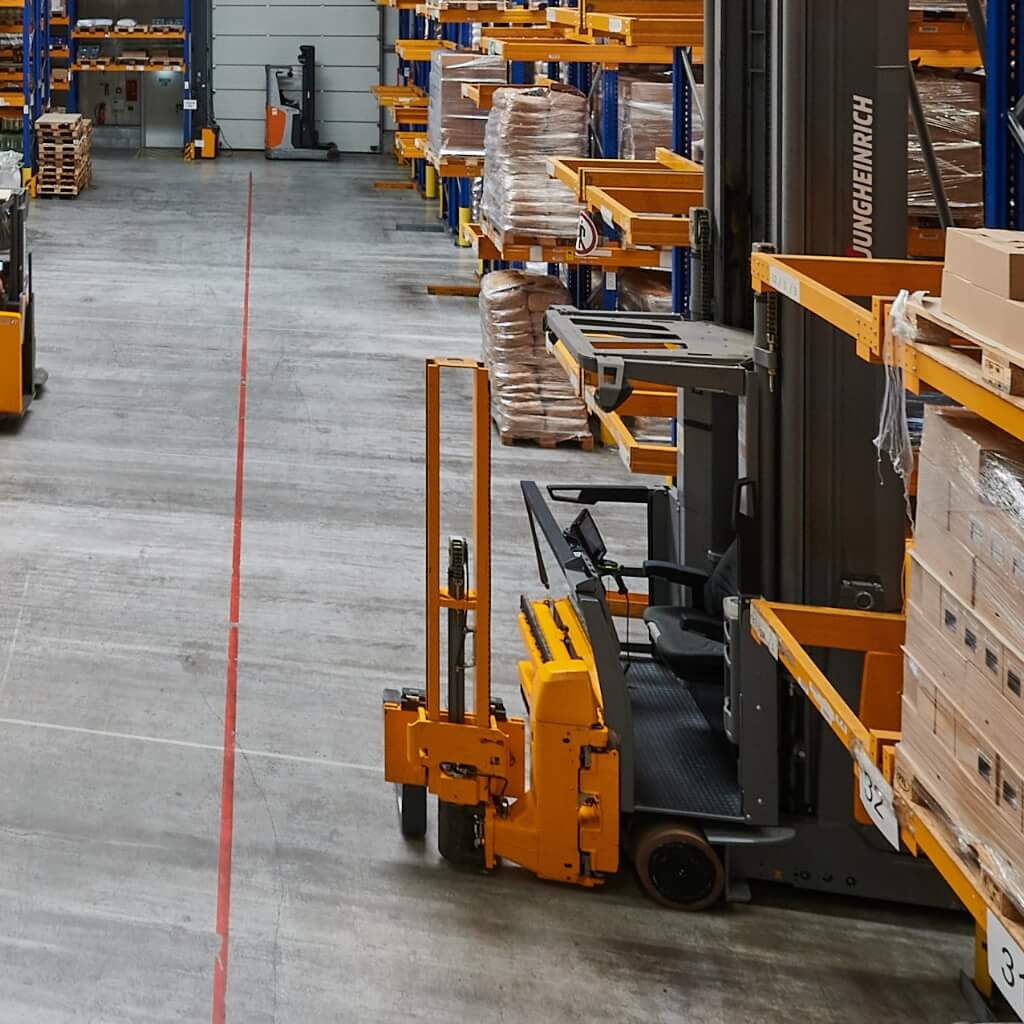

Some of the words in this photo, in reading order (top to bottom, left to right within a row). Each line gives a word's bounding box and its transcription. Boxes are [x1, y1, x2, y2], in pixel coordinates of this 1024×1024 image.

[852, 94, 873, 260] JUNGHEINRICH
[863, 769, 884, 821] 32
[1001, 946, 1024, 988] 3
